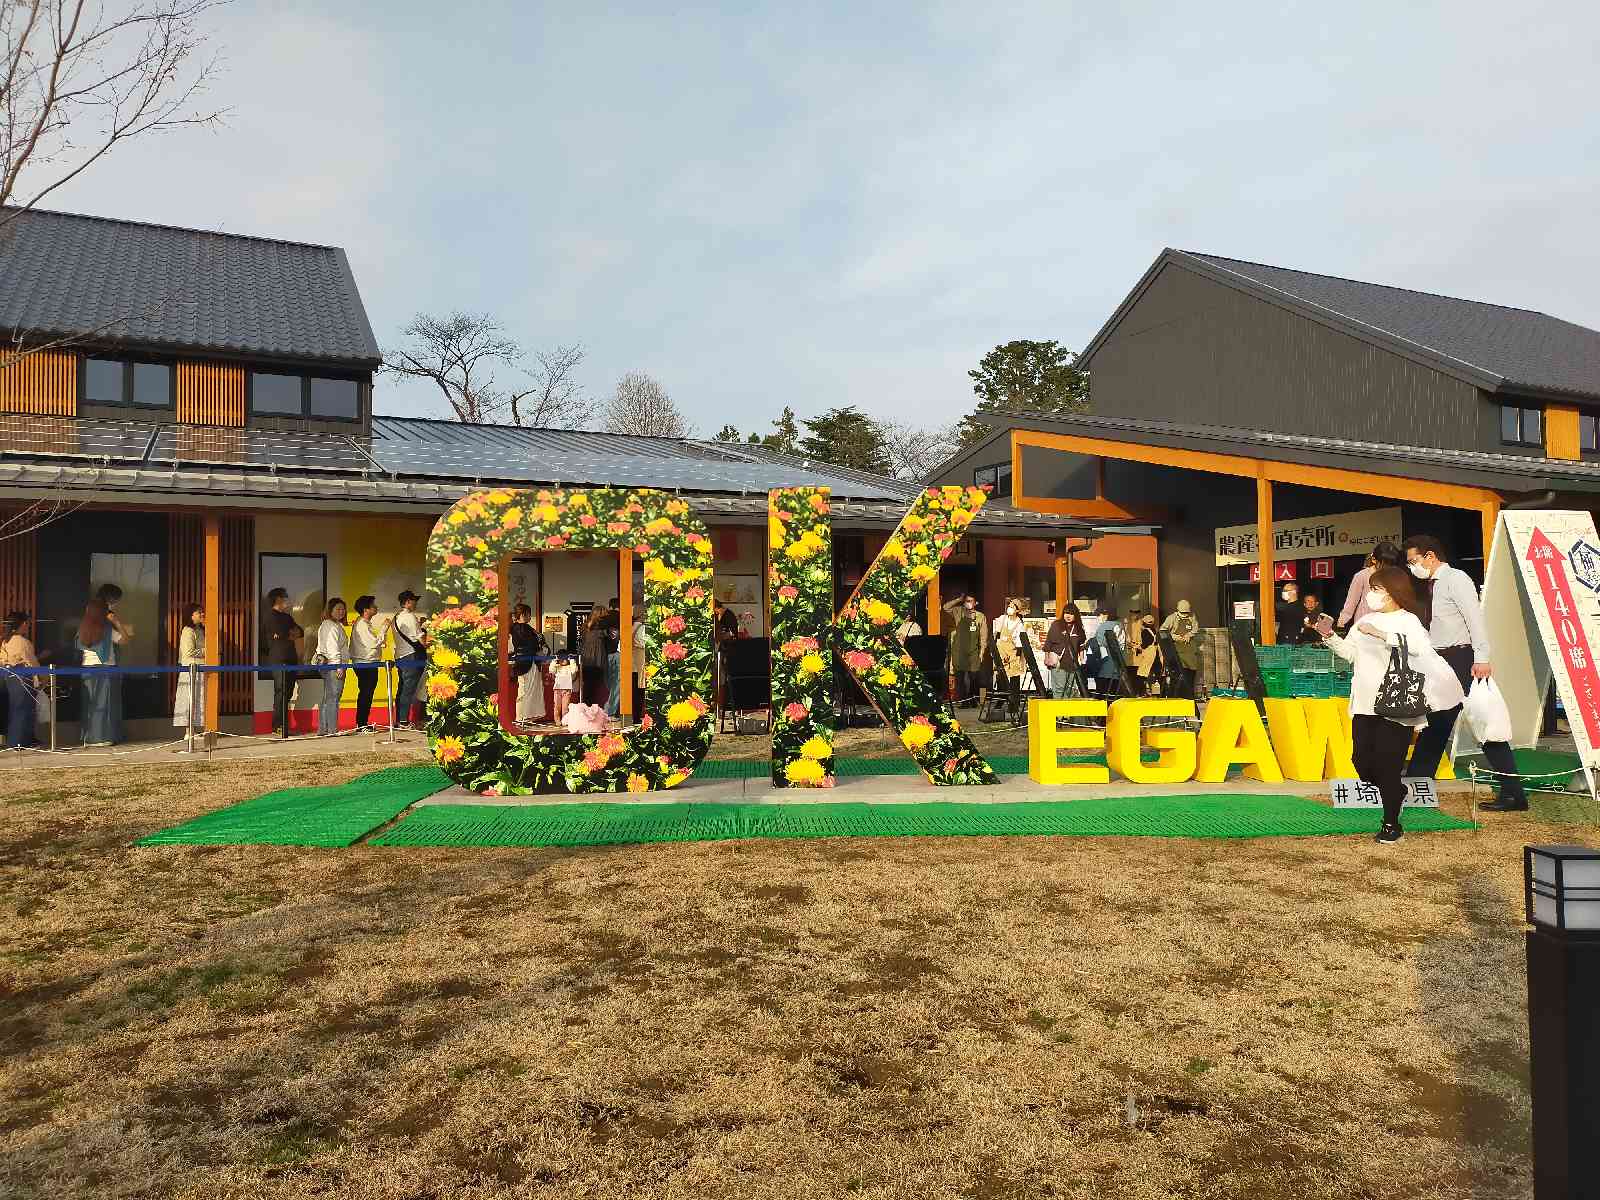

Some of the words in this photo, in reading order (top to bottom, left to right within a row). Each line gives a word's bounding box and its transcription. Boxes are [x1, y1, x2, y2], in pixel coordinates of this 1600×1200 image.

[1219, 524, 1335, 556] 農産直売所
[1334, 780, 1435, 805] #埼県
